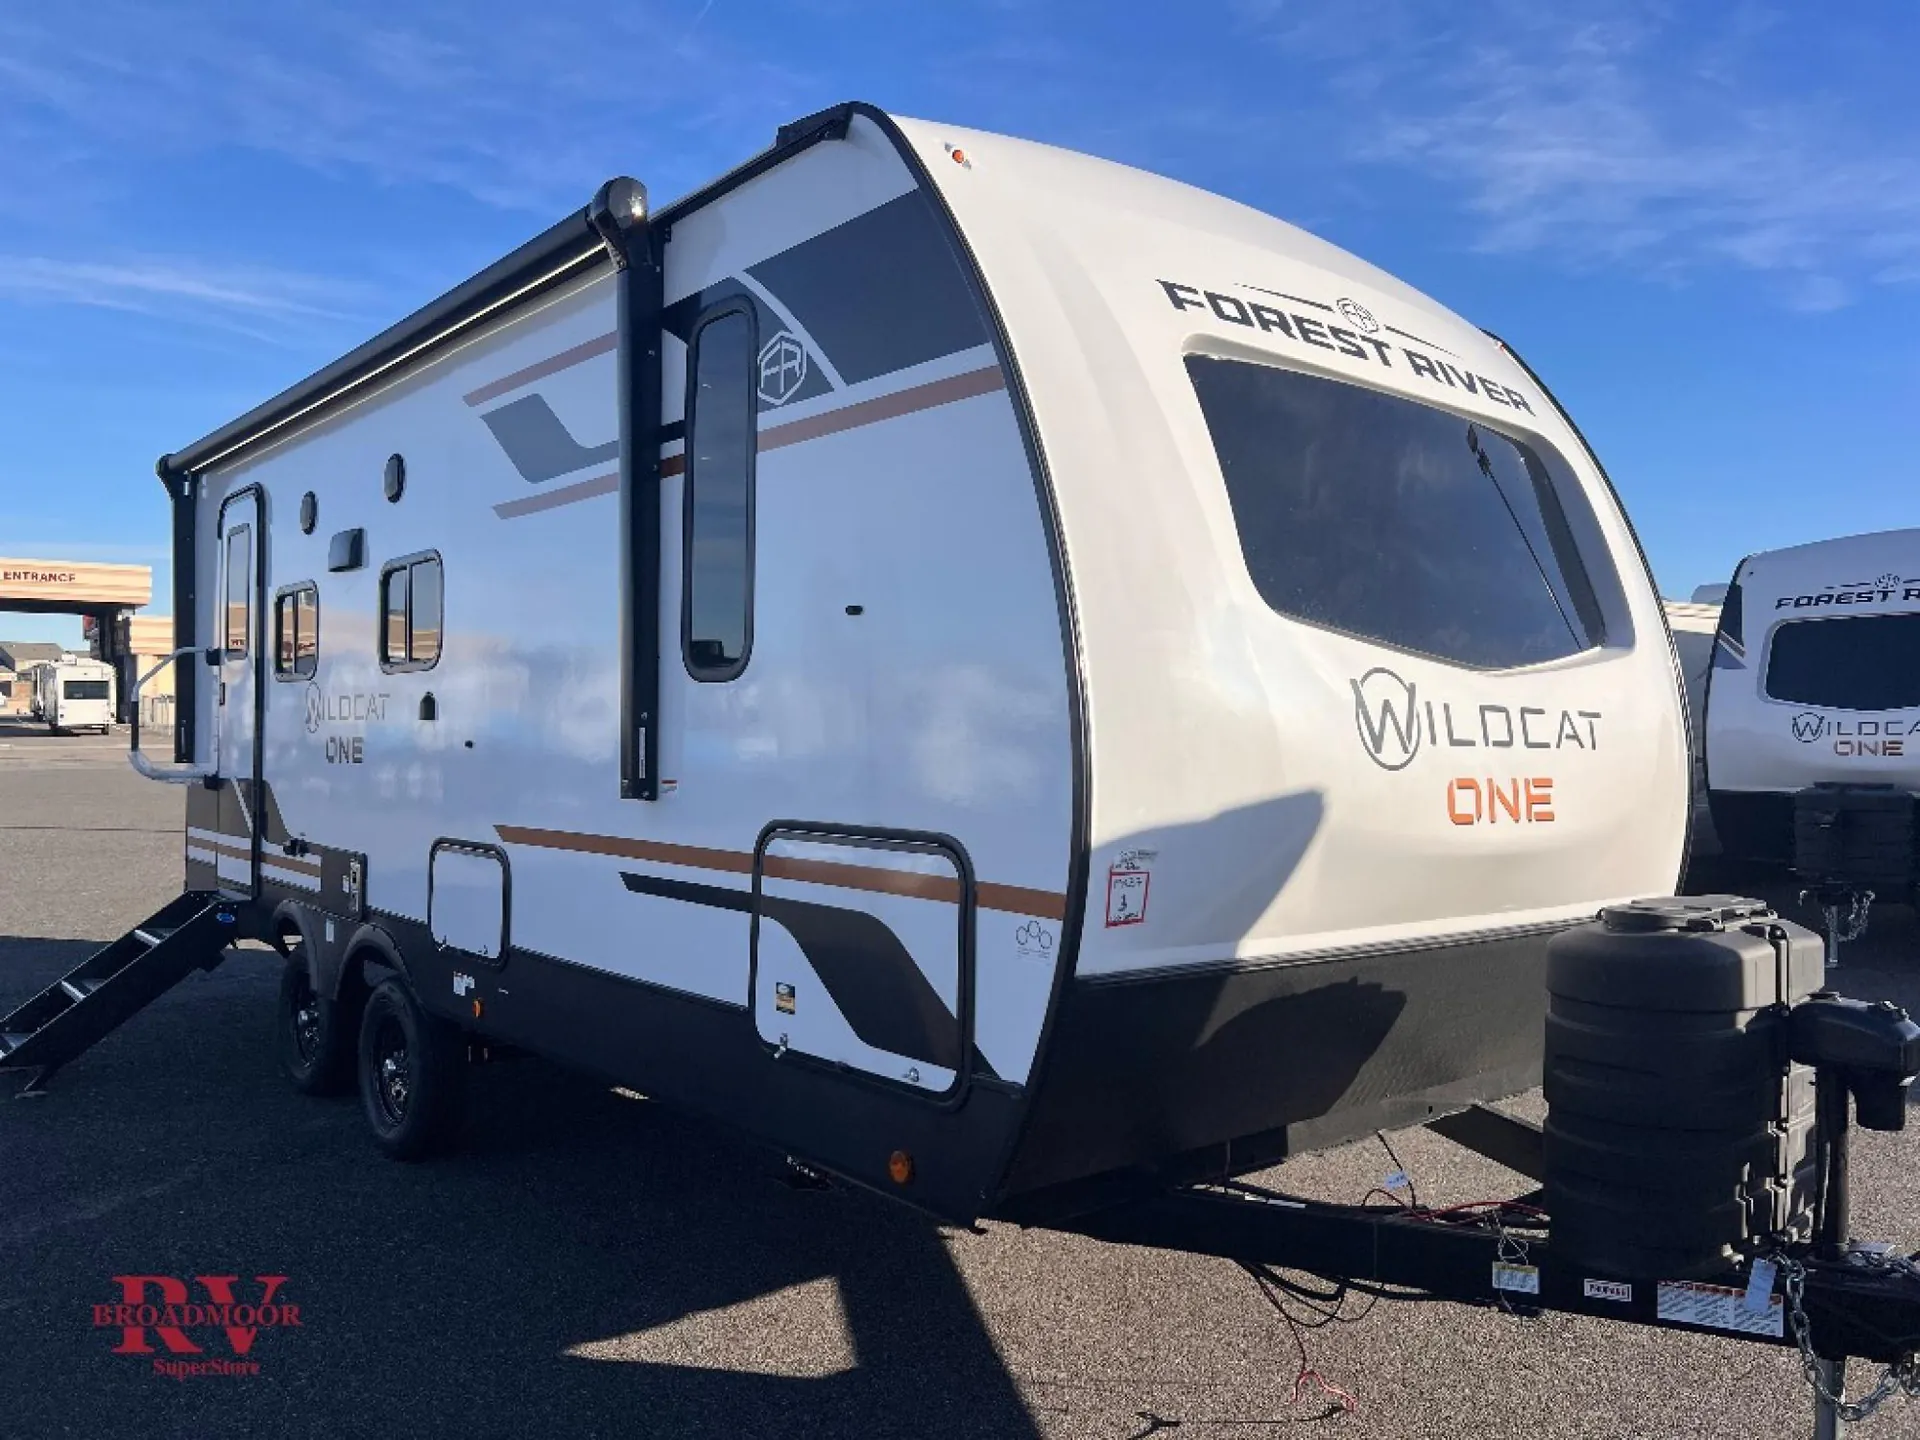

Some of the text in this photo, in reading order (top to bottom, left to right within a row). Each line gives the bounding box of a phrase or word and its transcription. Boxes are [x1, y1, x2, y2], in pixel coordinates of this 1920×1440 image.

[1156, 279, 1392, 367] FOREST
[1401, 346, 1536, 416] RIVER
[3, 571, 76, 582] ENTRANCE
[1775, 589, 1896, 610] FOREST
[306, 681, 391, 733] WILDCAT
[1349, 667, 1602, 771] WILDCAT
[326, 736, 364, 764] ONE
[1834, 740, 1903, 756] ONE
[1447, 778, 1555, 825] ONE
